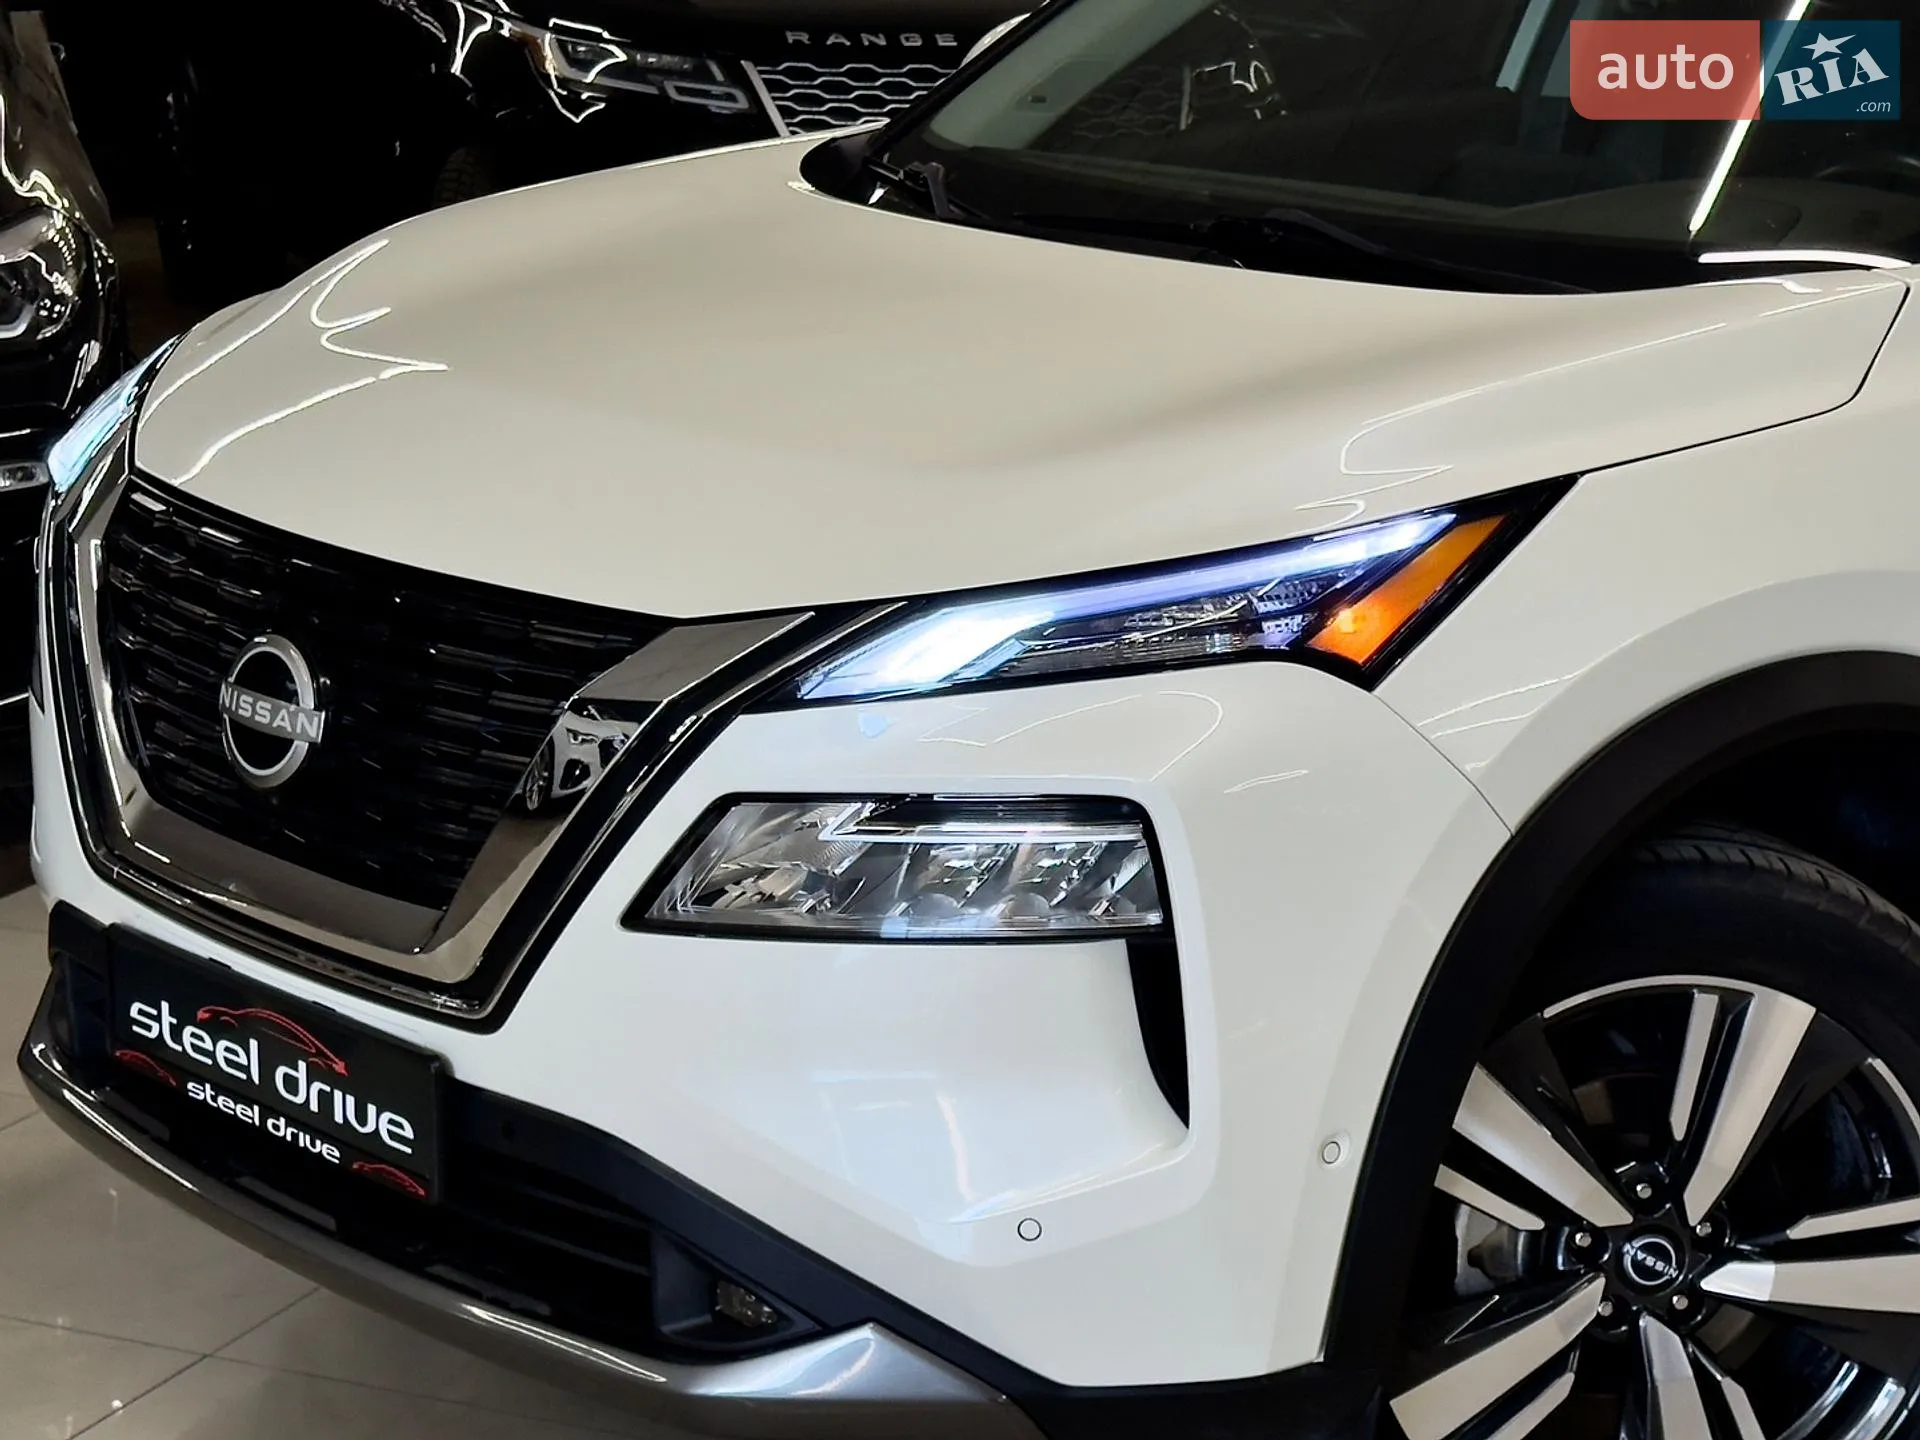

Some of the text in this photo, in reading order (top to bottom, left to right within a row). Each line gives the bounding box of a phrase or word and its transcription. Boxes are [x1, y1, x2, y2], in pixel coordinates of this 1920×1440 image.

[785, 30, 958, 47] RANGE
[219, 681, 320, 739] NISSAN
[129, 1000, 415, 1154] steel drive
[187, 1080, 341, 1164] steel drive
[1622, 1242, 1679, 1279] NISSAN
